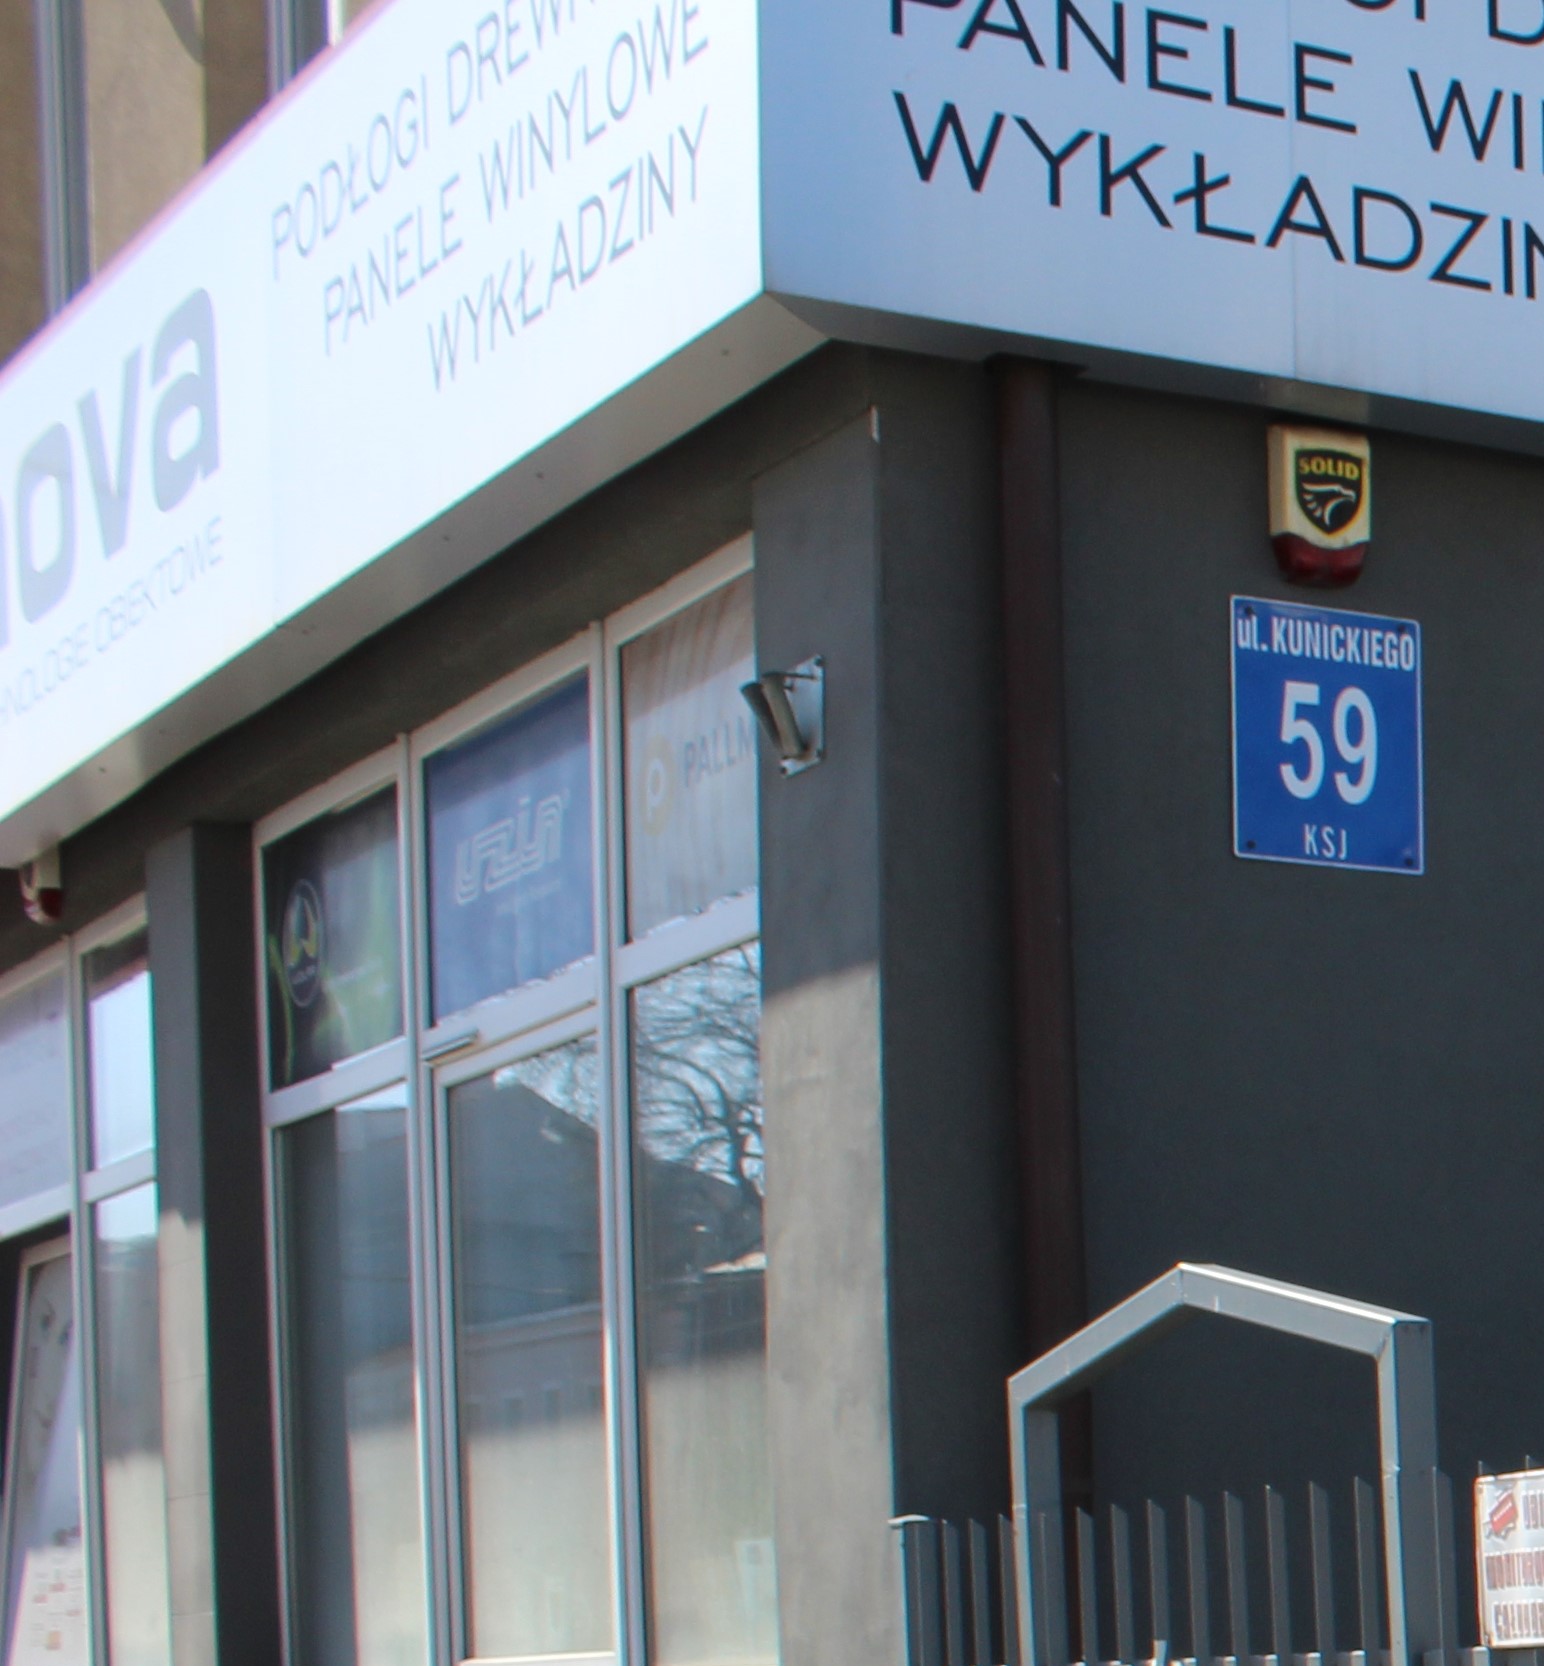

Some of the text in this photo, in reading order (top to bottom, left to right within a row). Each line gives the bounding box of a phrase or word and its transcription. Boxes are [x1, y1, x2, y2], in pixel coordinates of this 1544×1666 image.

[271, 73, 430, 281] PODŁOGI
[323, 0, 709, 357] PANELE WINYLOWE
[427, 104, 709, 392] WYKŁADZINY
[0, 287, 221, 650] ova
[1298, 456, 1360, 481] SOLID
[1237, 616, 1416, 672] ul. KUNICKIEGO
[1279, 680, 1379, 805] 59
[1303, 823, 1348, 861] KSJ
